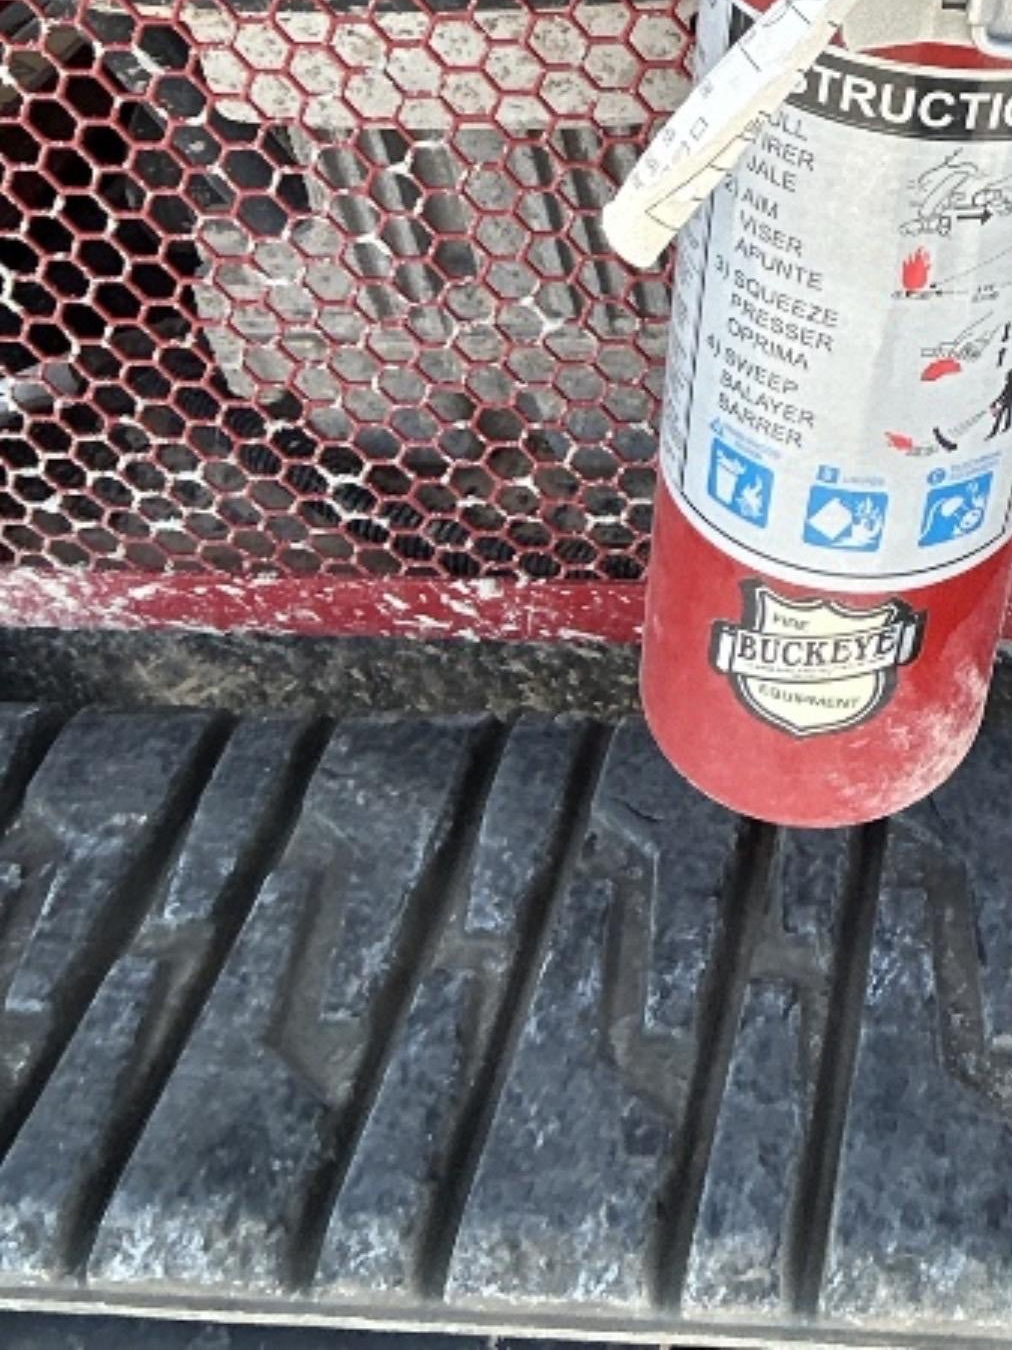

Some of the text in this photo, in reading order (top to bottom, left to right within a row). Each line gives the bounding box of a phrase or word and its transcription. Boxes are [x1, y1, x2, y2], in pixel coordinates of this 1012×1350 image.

[767, 111, 808, 142] ULL
[746, 155, 797, 193] JALE
[760, 132, 815, 172] IRER
[741, 188, 778, 220] AIM
[740, 210, 803, 259] VISER
[734, 237, 823, 292] APUNTE
[730, 293, 835, 352] PRESSER
[733, 269, 839, 328] SQUEEZE
[727, 317, 808, 370] OPRIMA
[725, 347, 799, 393] SWEEP
[719, 392, 802, 448] BARRER
[720, 369, 814, 430] BALAYER
[738, 628, 895, 667] BUCKEYE
